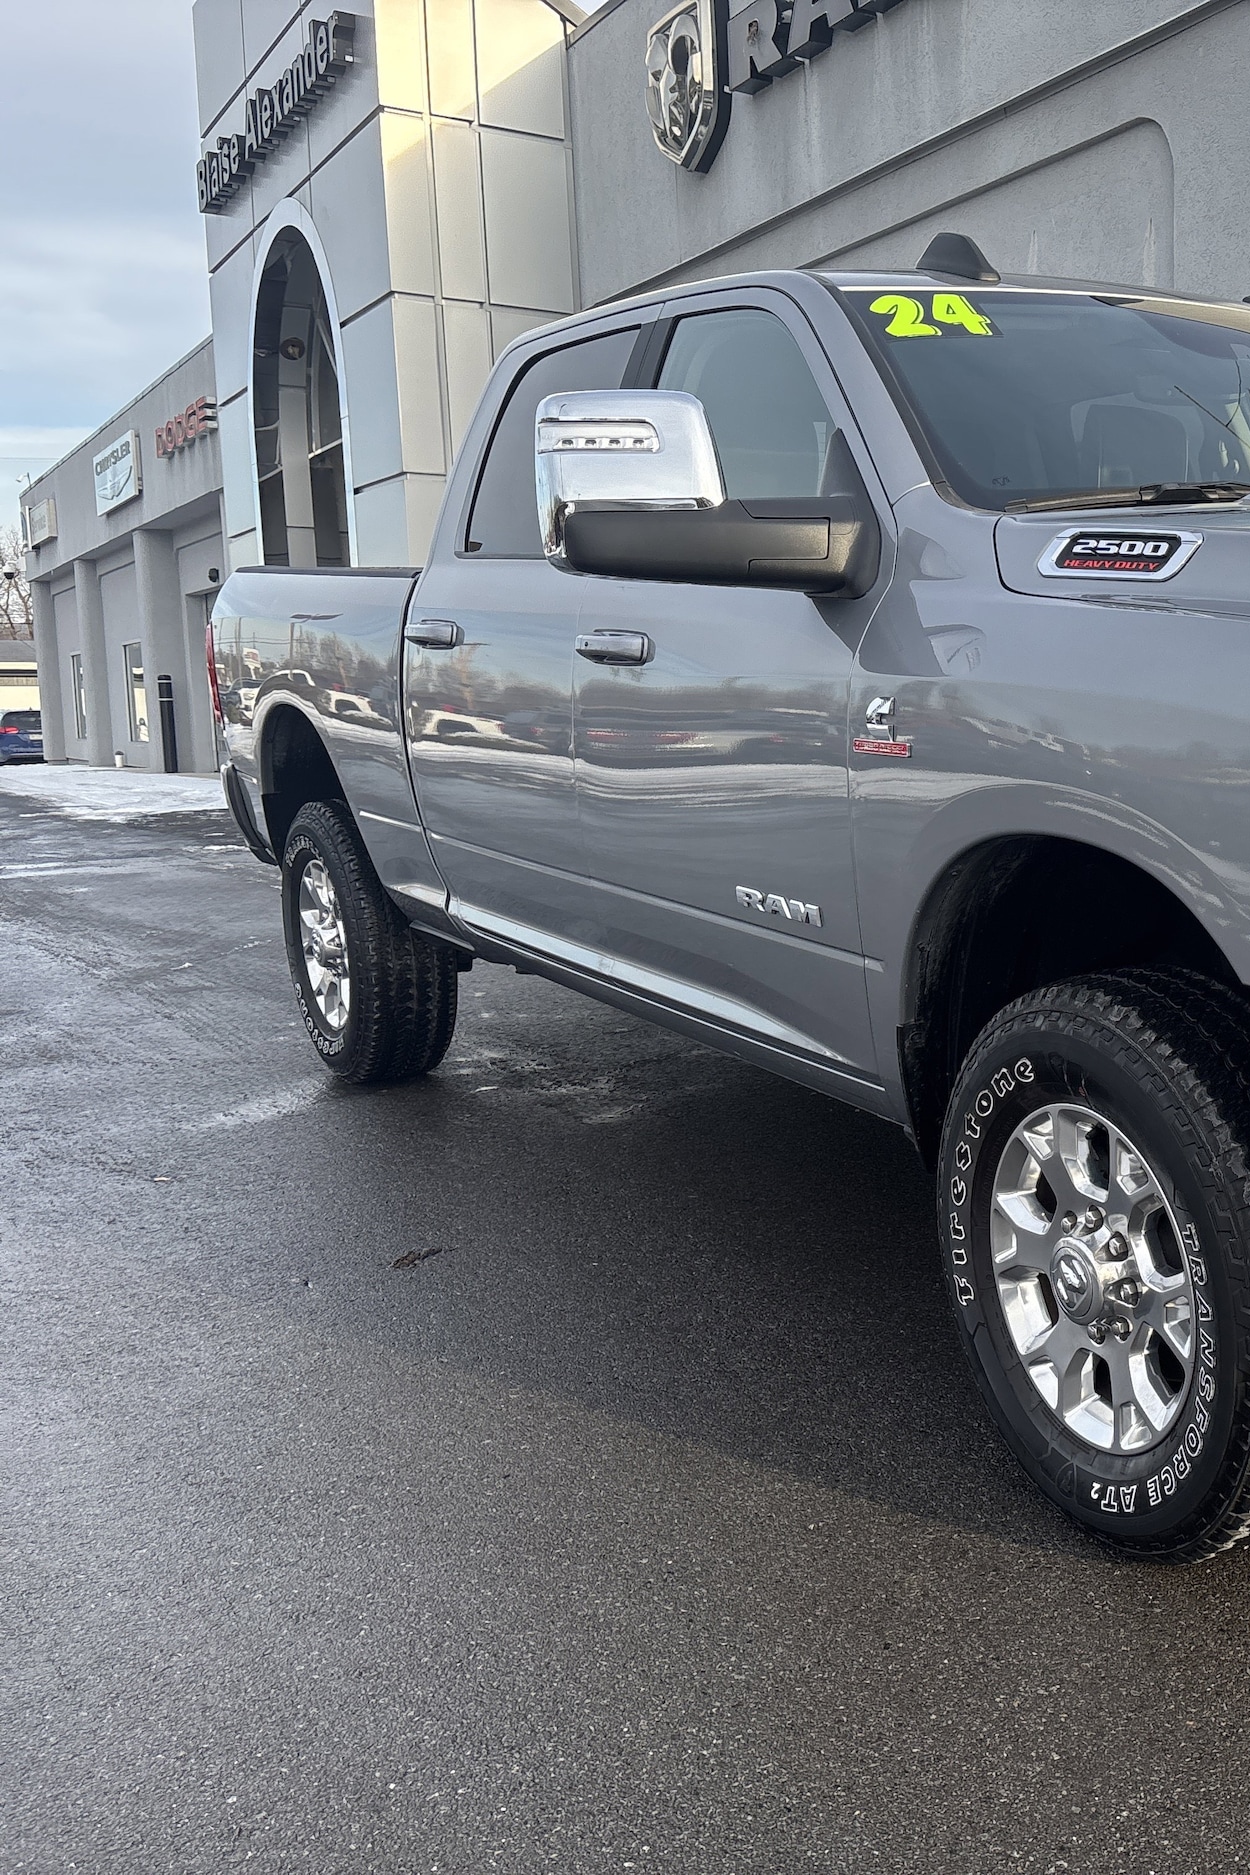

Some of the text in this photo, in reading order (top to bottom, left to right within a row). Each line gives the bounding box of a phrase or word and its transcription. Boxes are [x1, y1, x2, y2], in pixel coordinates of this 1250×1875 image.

[196, 10, 350, 213] Blaise Alexander
[869, 294, 993, 337] 24
[155, 395, 215, 459] DODGE
[95, 440, 131, 477] CHRYSLER
[1063, 558, 1160, 571] HEAVY DUTY
[1072, 539, 1170, 557] 2500
[735, 885, 823, 928] RAM
[1147, 1222, 1216, 1506] TRANSFORCE
